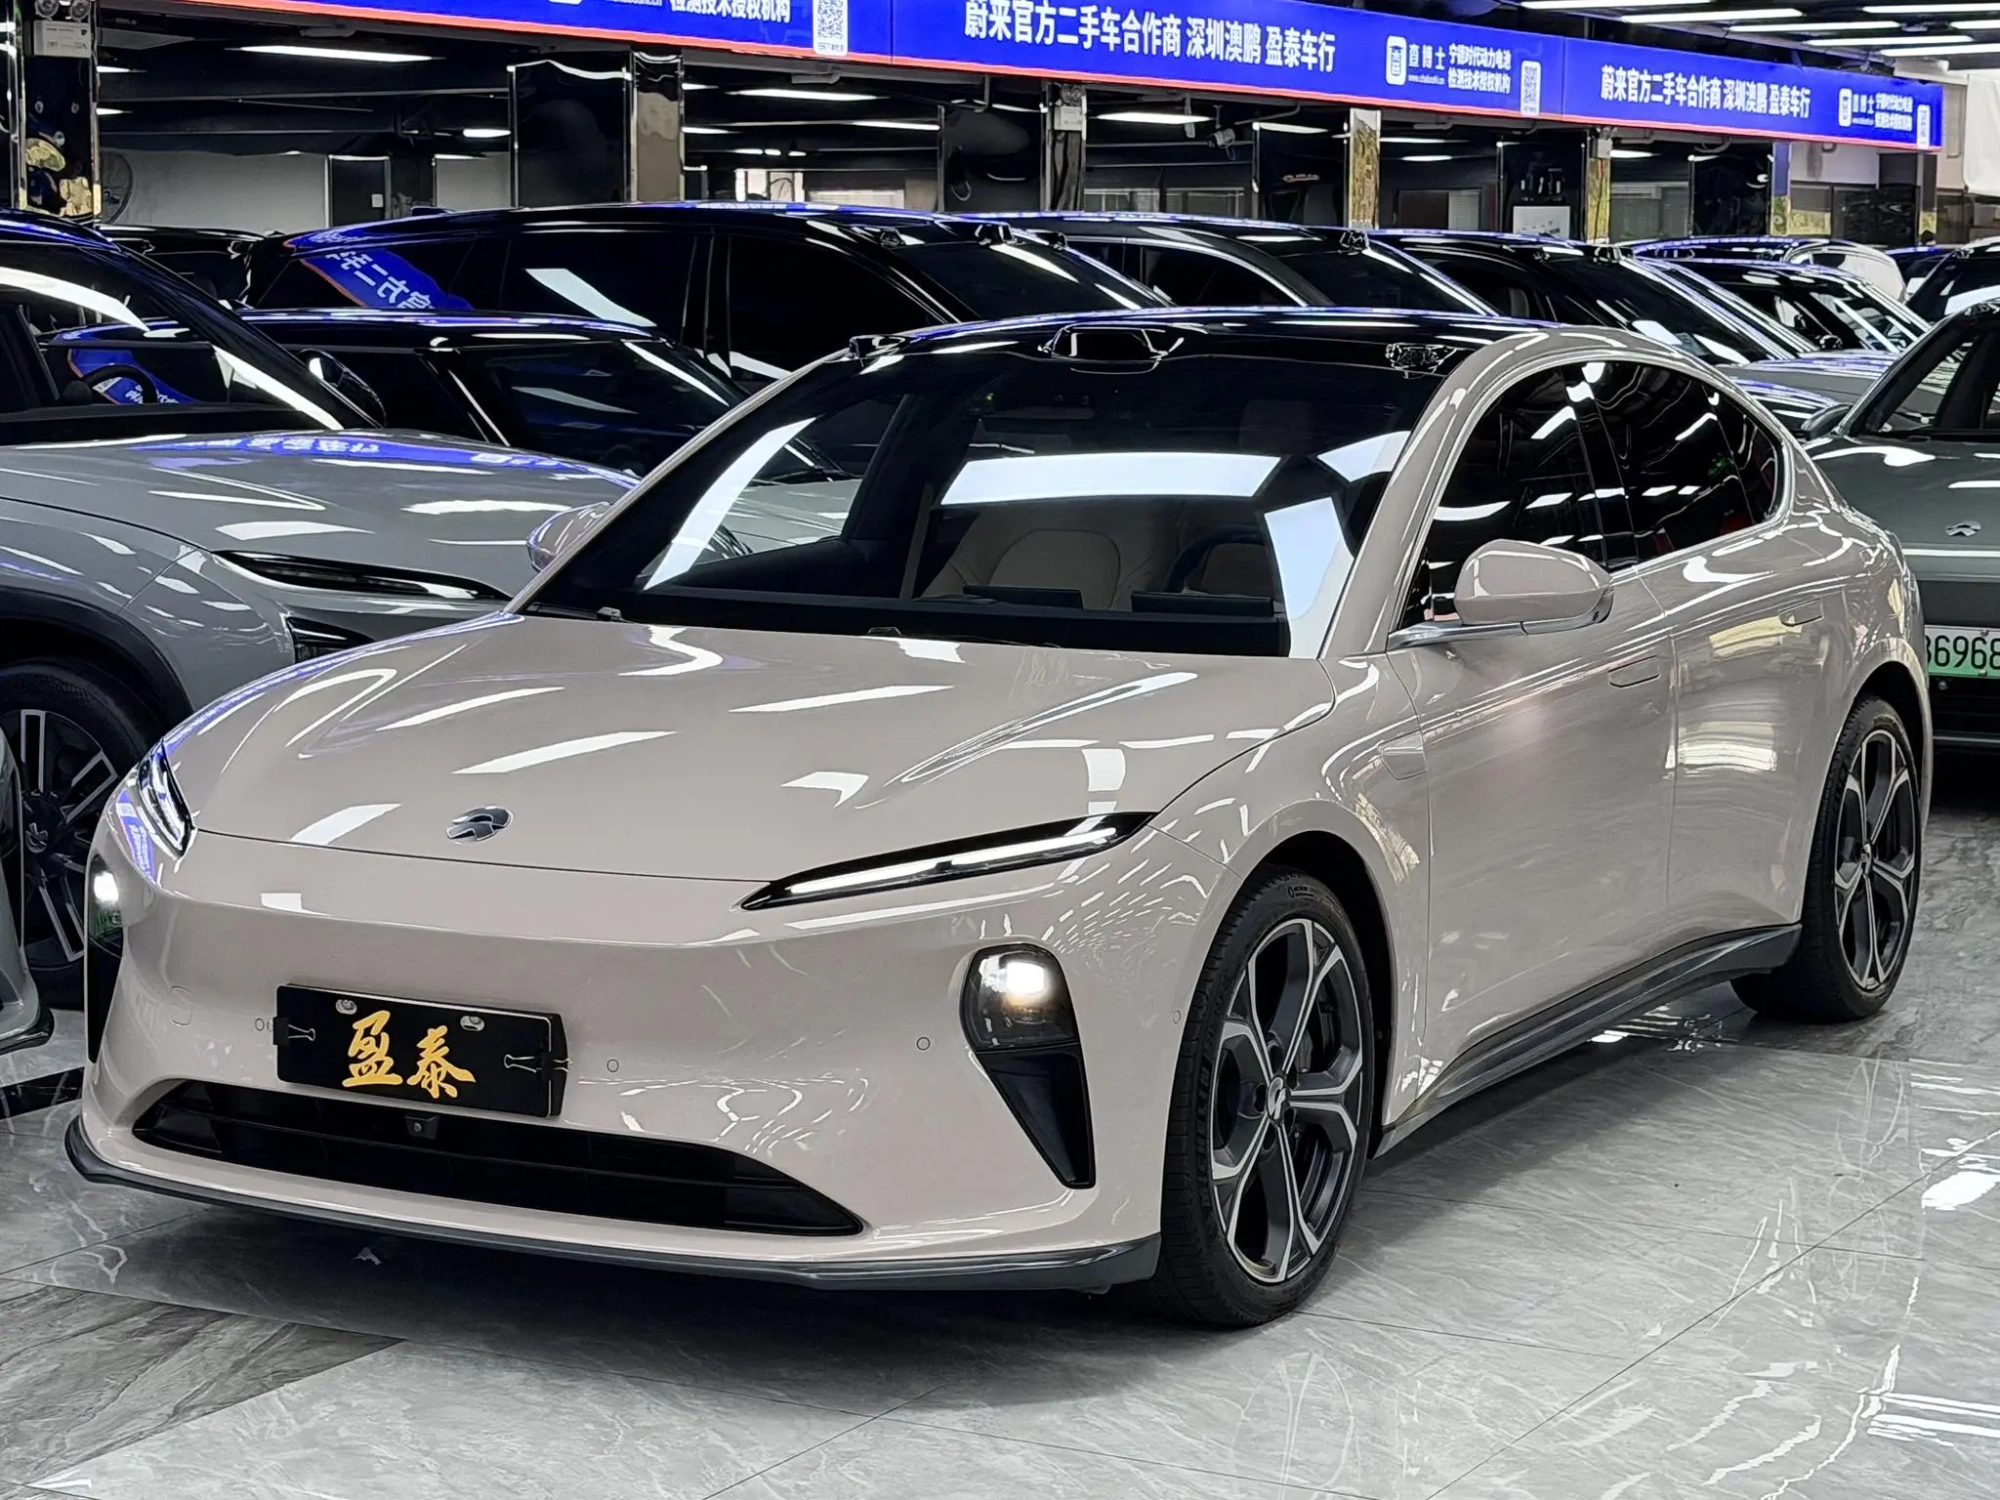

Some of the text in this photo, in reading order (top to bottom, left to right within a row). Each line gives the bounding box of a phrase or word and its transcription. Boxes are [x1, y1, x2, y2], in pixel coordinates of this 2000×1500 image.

[964, 0, 1337, 73] 蔚来官方二手车合作商 深圳澳鹏 盈泰车行
[1600, 64, 1721, 110] 蔚来官方二手车合作商
[342, 1010, 476, 1099] 盈泰
